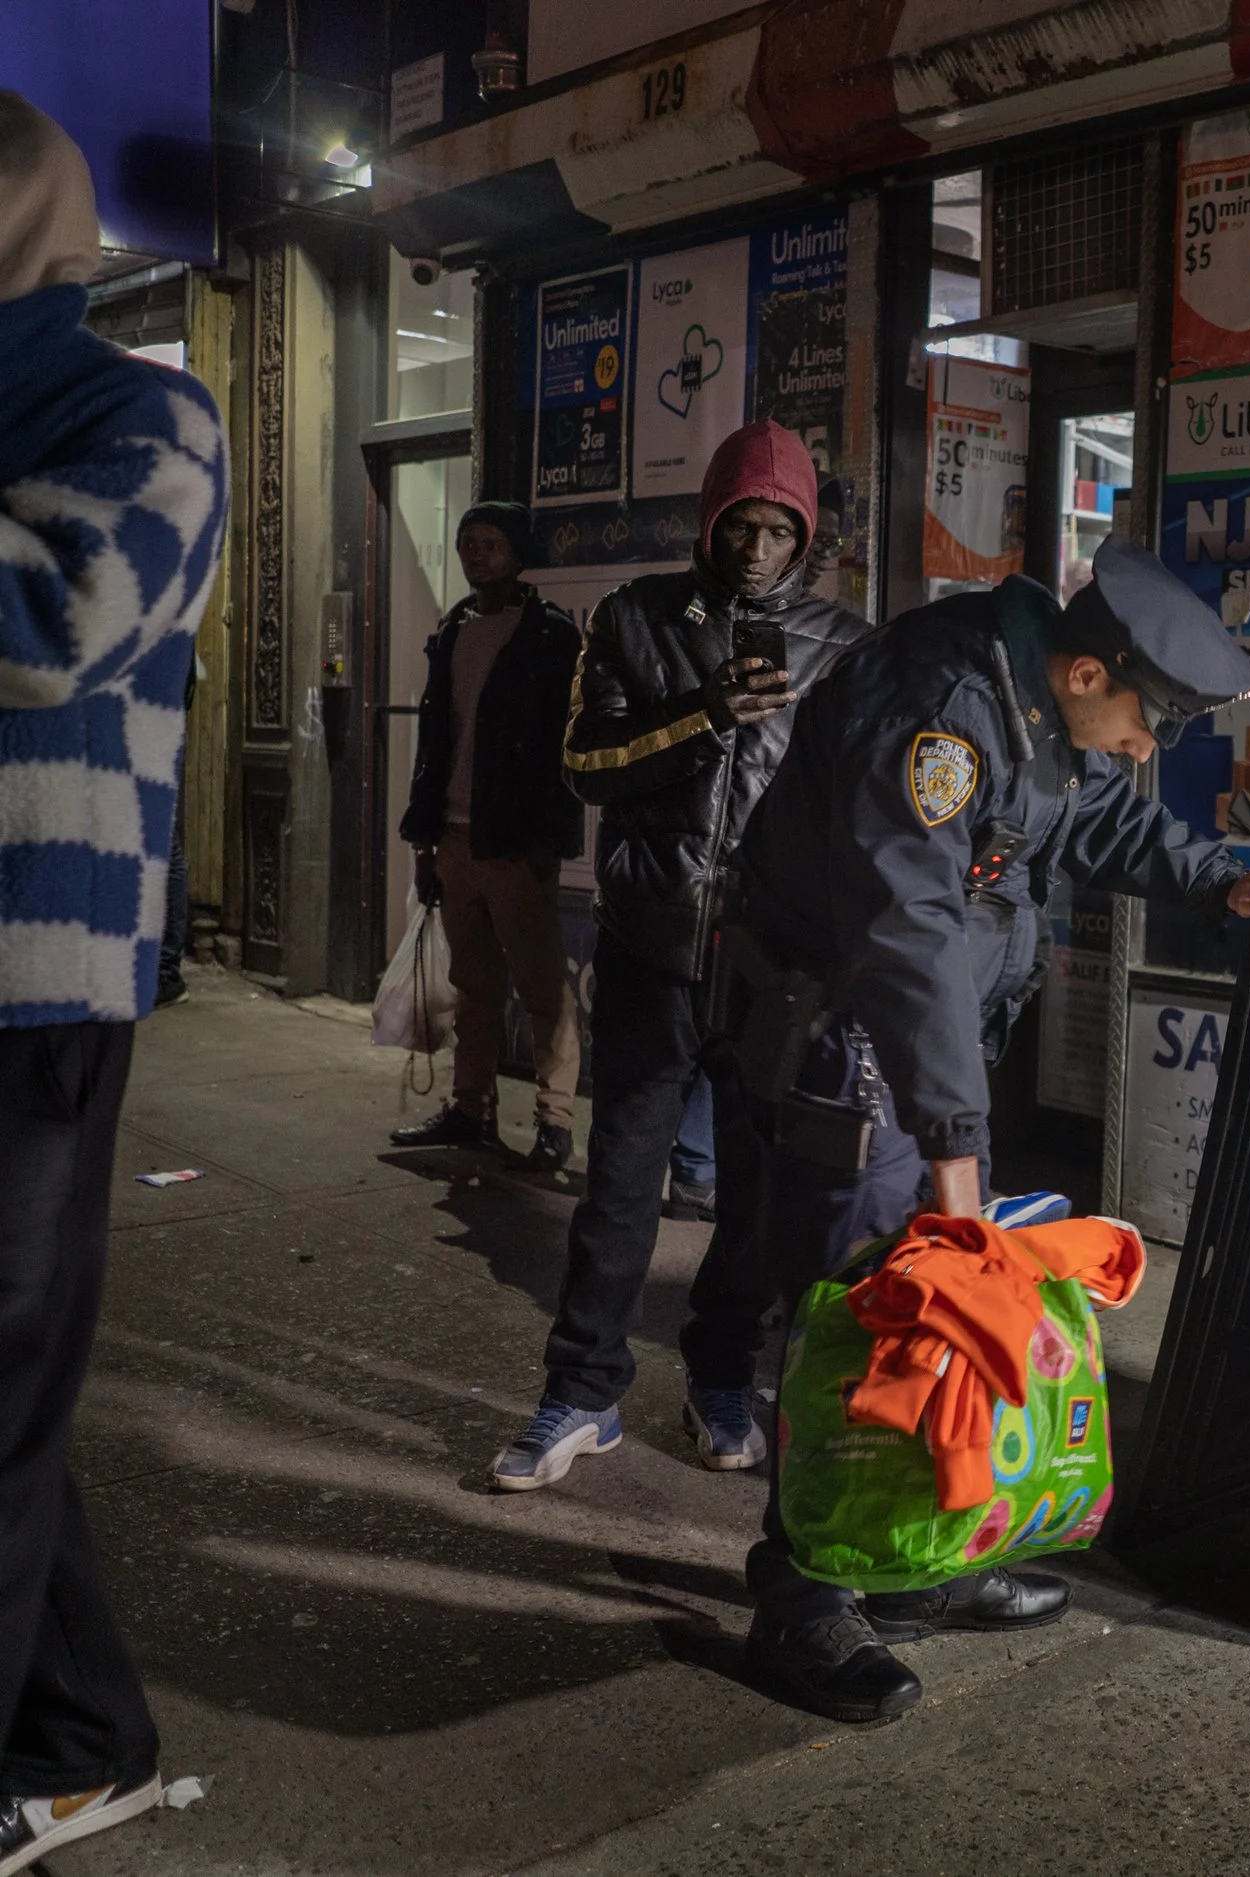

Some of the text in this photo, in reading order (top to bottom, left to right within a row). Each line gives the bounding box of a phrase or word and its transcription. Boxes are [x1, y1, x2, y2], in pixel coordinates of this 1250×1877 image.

[642, 62, 685, 119] 129
[1185, 201, 1216, 238] 50
[1184, 243, 1211, 276] $5
[653, 281, 683, 304] Lyca
[544, 308, 620, 351] Unlimited
[788, 344, 844, 368] 4 Lines
[936, 437, 1029, 468] 50 minutes
[1220, 445, 1246, 457] CALL
[540, 466, 568, 488] Lyca
[934, 470, 963, 497] $5
[936, 738, 968, 757] POLICE
[914, 767, 924, 791] CITY
[1070, 910, 1109, 937] Lyca
